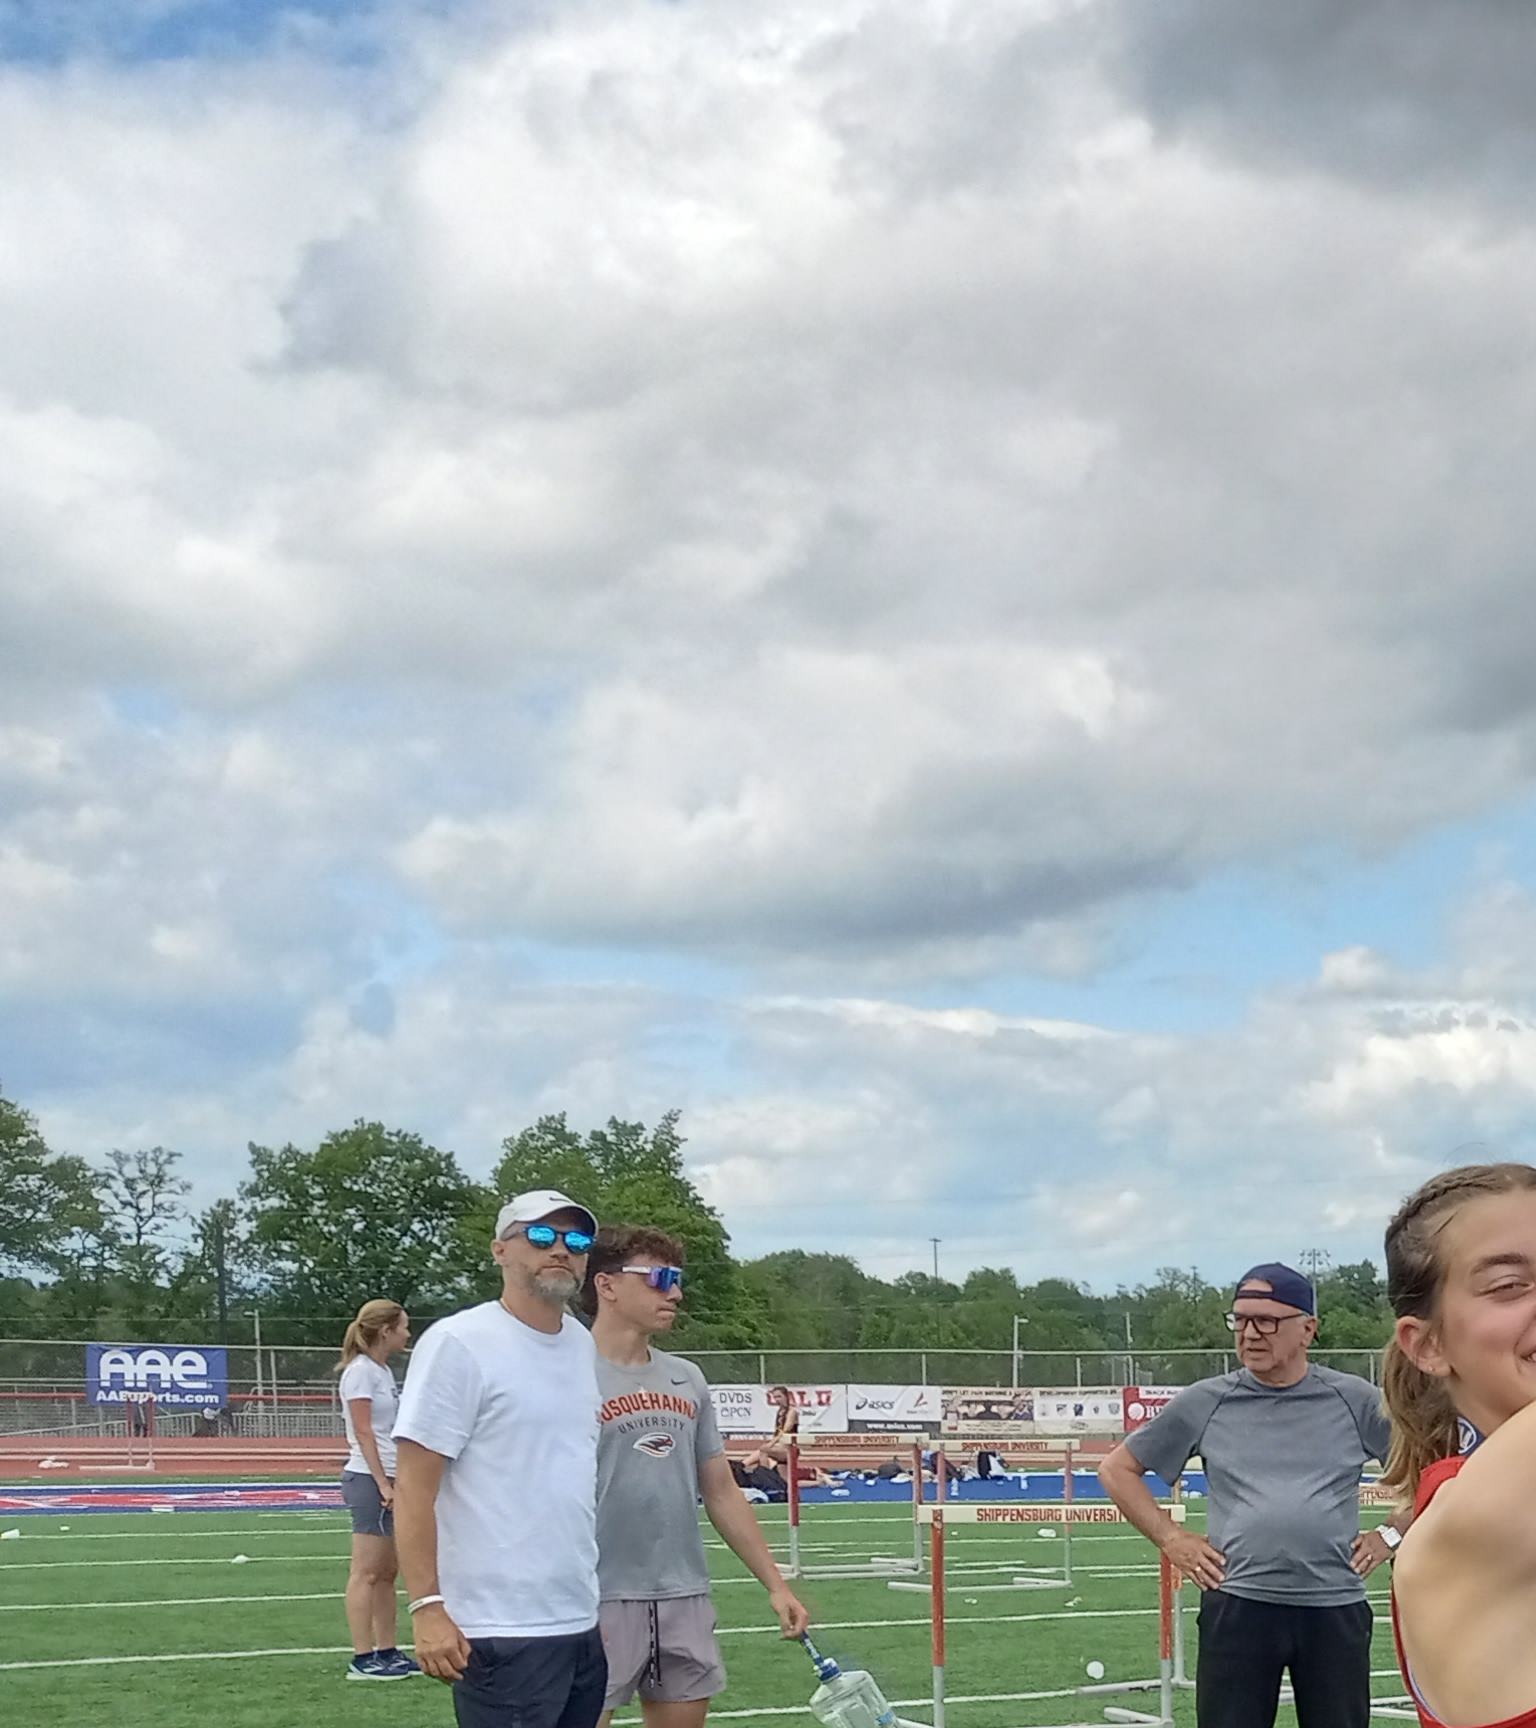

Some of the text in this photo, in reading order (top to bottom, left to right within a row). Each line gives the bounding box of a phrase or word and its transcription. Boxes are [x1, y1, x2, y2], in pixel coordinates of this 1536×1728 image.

[720, 1392, 752, 1404] DVDS
[597, 1393, 699, 1424] USQUEHANN
[617, 1416, 685, 1434] UNIVERSITY
[977, 1508, 1061, 1521] SHIPPENSBURG
